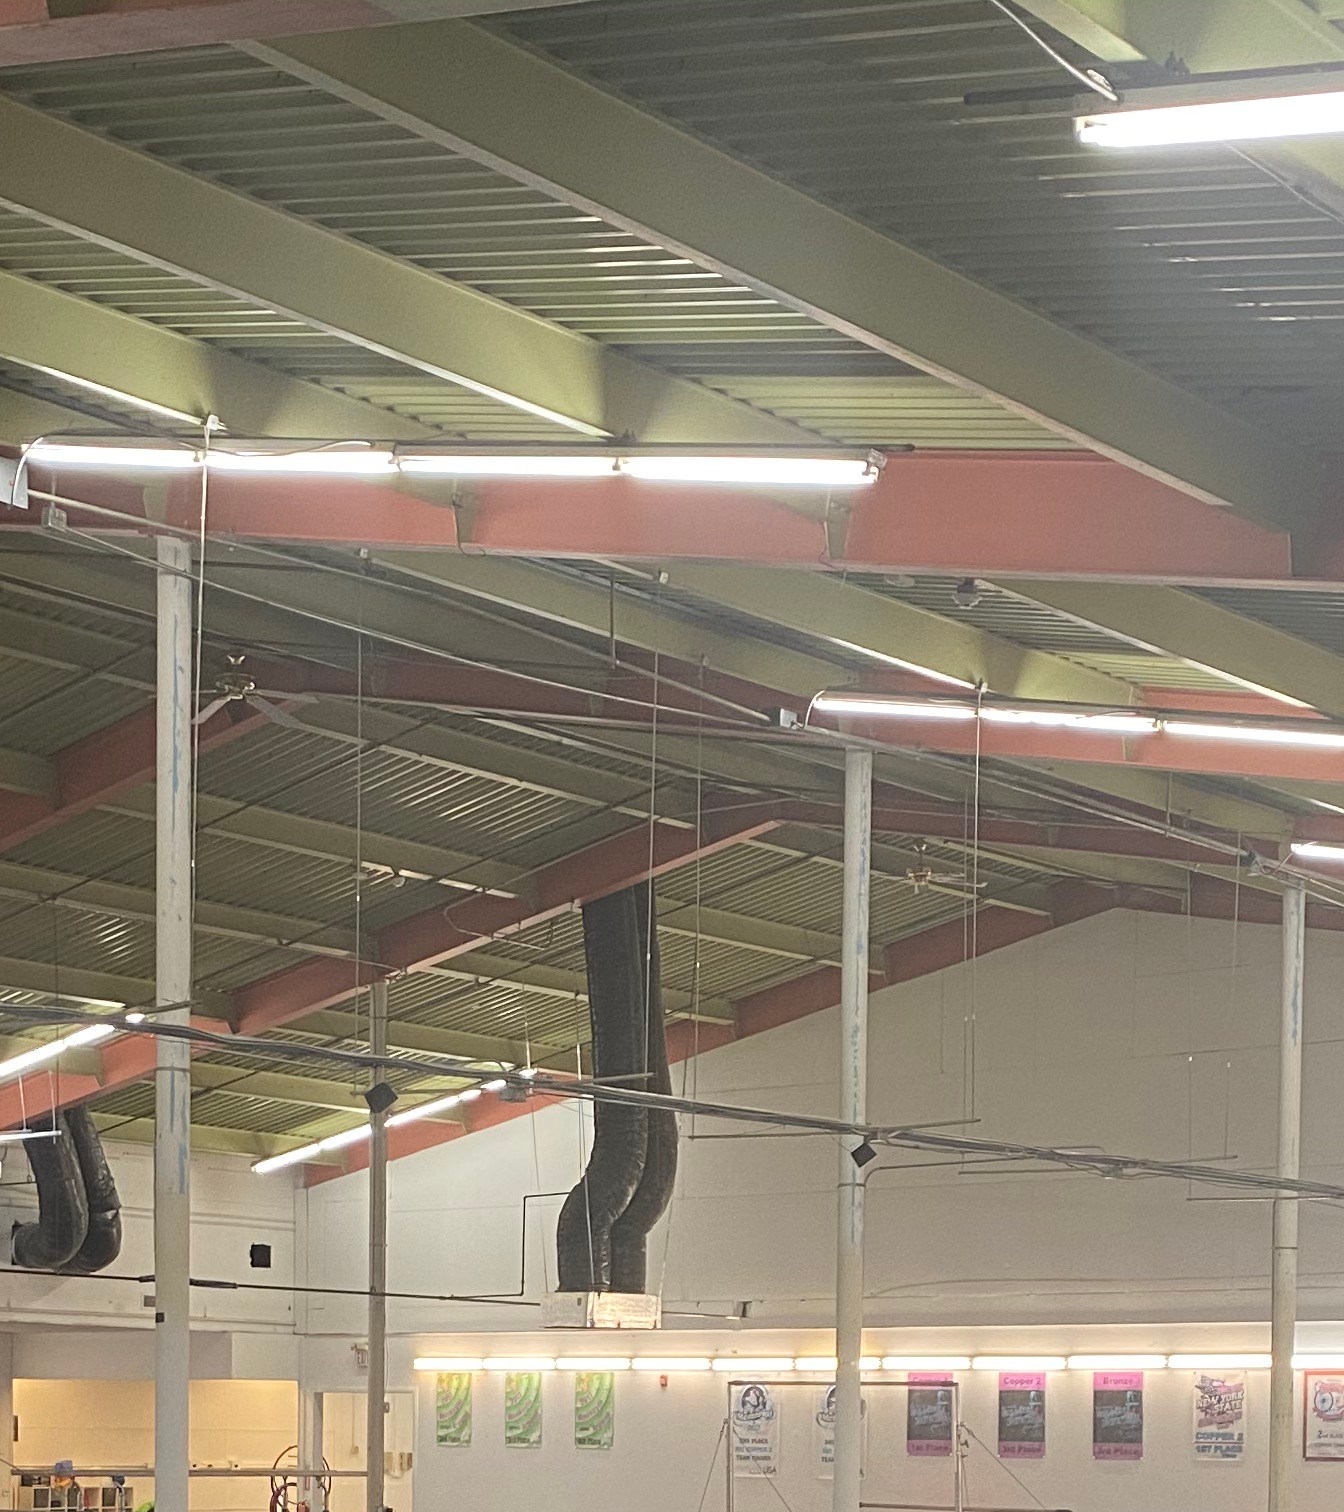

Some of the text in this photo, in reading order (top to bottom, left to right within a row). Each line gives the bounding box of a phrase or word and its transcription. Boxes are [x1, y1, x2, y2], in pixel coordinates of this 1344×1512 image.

[1003, 1377, 1041, 1386] Copper 2
[1102, 1377, 1134, 1385] Bronze
